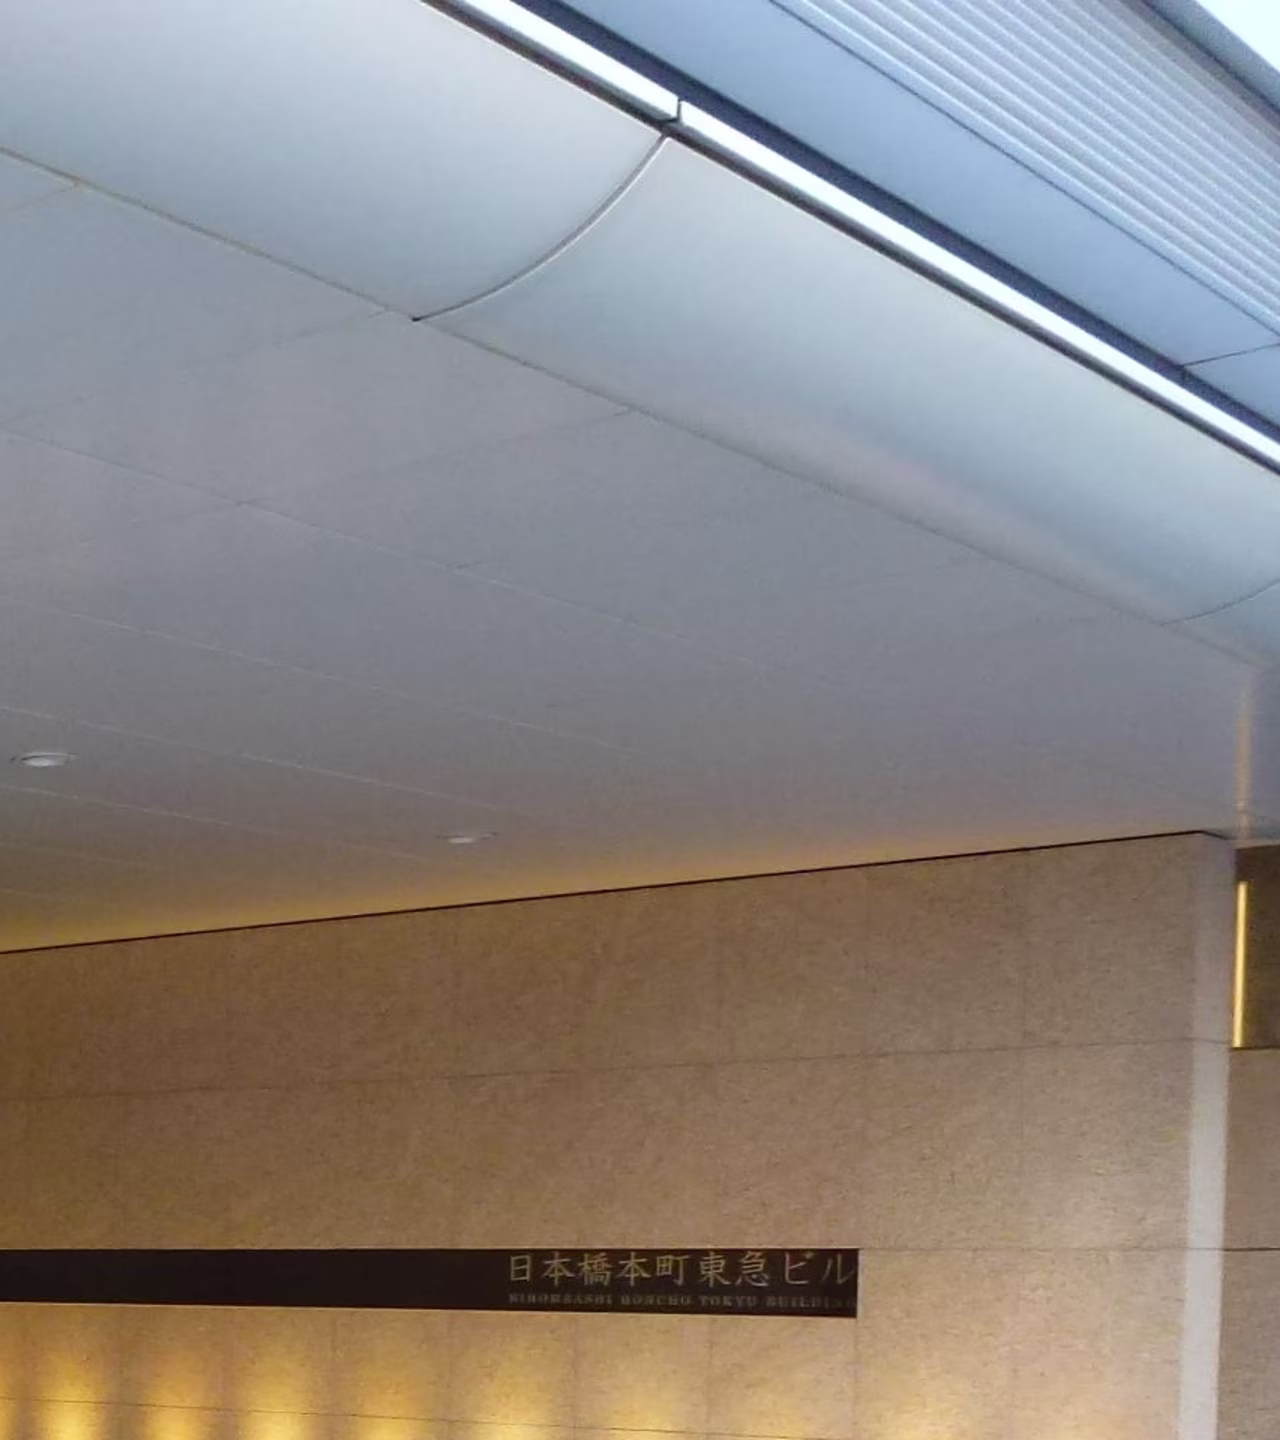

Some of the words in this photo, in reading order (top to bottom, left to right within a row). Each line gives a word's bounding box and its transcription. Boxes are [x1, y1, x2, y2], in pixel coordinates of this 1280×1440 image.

[509, 1250, 855, 1287] 日本橋本町東急ビル
[700, 1295, 757, 1308] TOKYU
